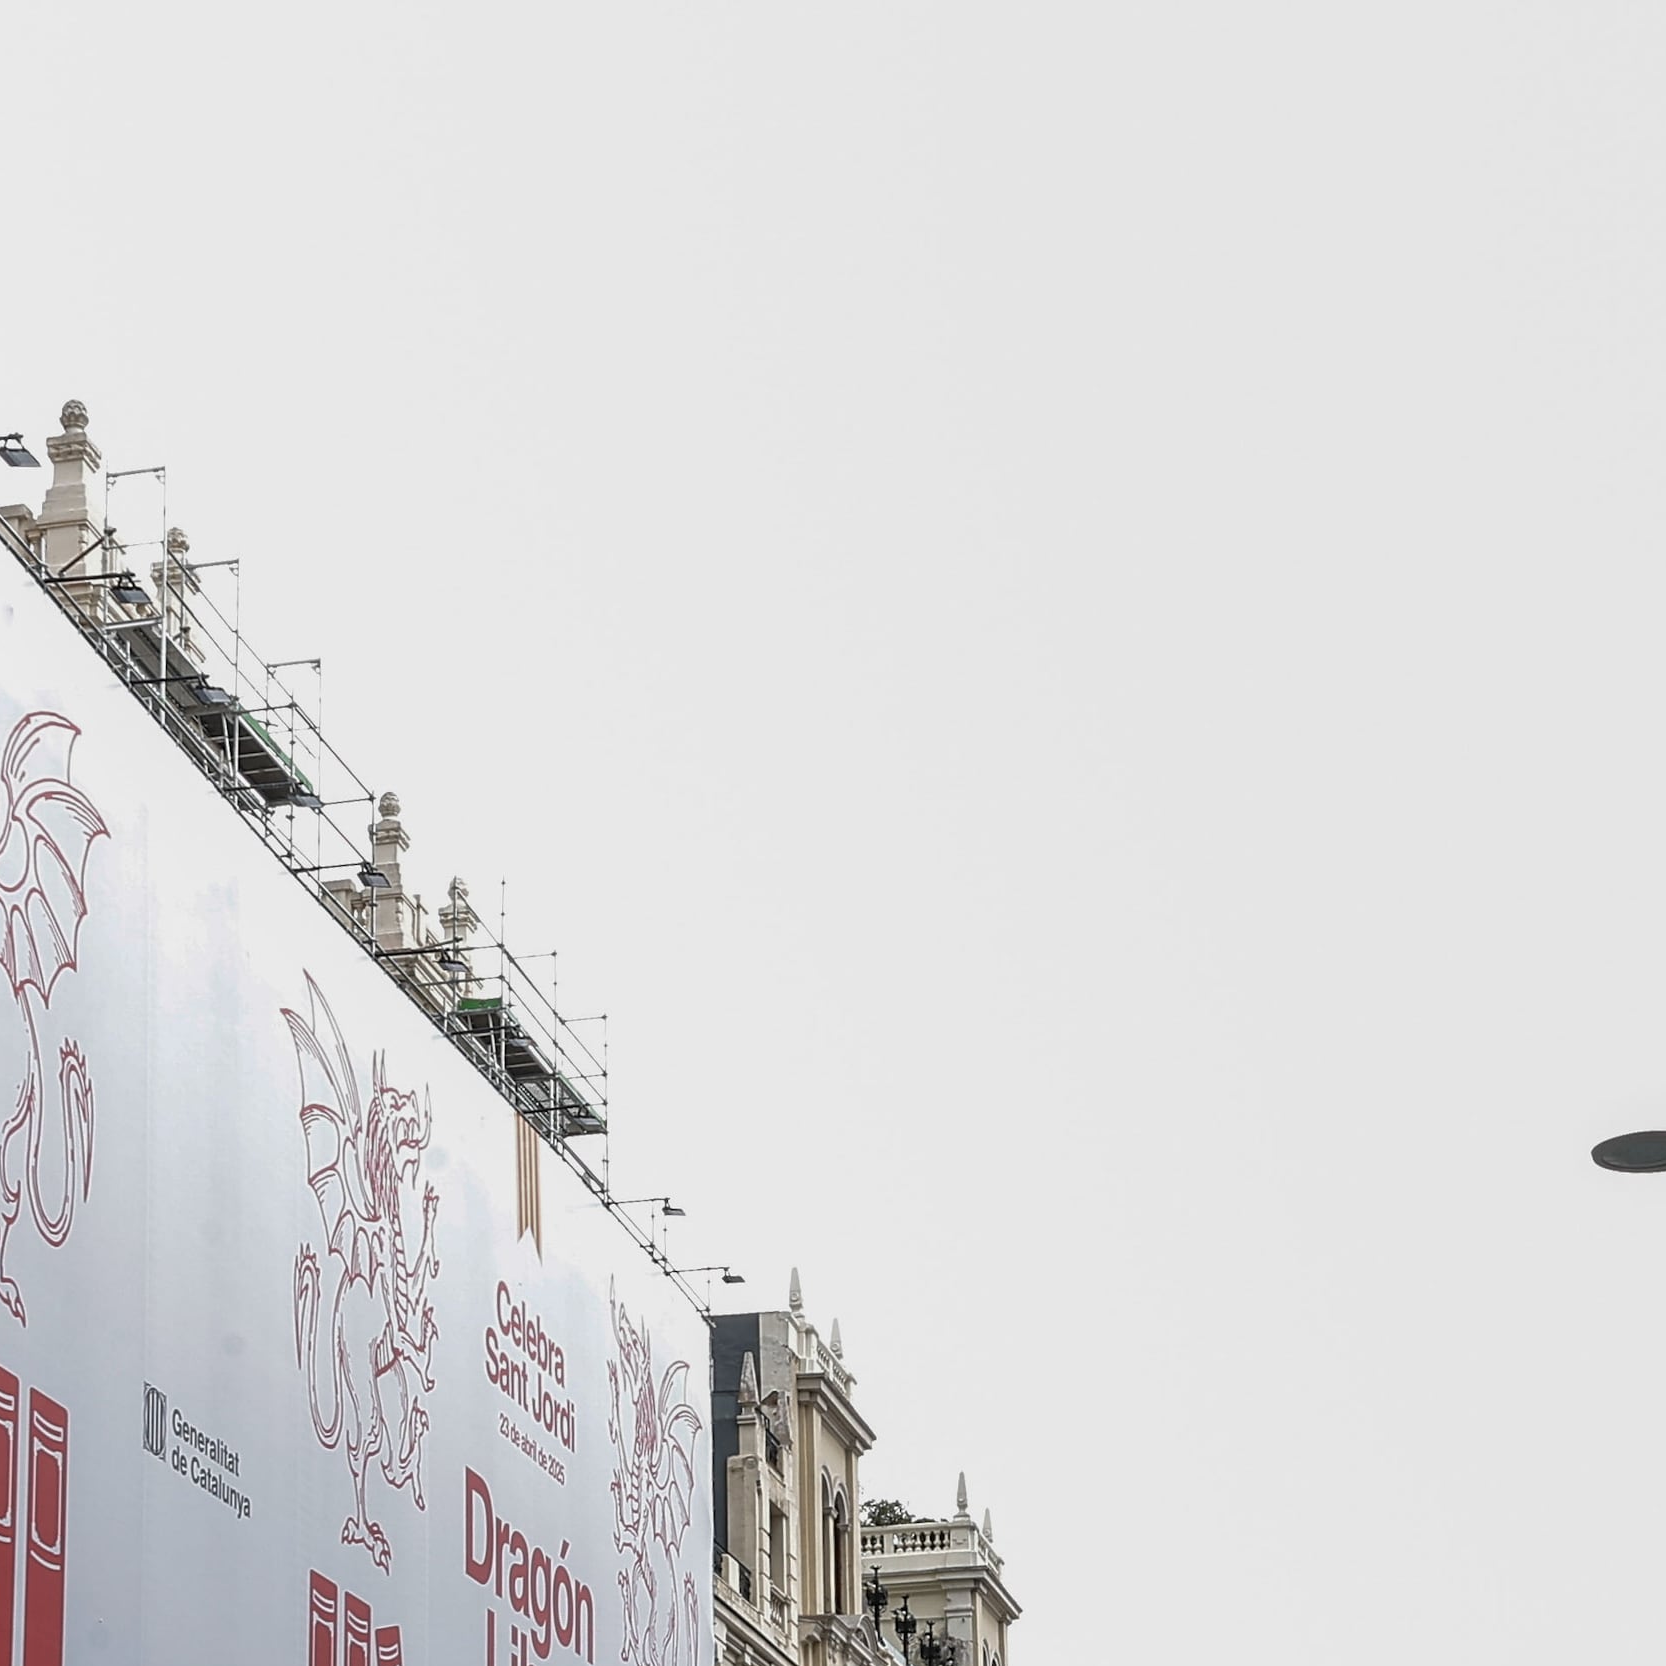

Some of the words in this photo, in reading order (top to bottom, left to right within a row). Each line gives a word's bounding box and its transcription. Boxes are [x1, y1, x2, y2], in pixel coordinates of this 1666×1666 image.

[496, 1281, 566, 1388] Celebra
[485, 1327, 529, 1413] Sant
[532, 1373, 575, 1453] Jordi
[171, 1445, 188, 1475] de
[190, 1456, 251, 1519] Catalunya
[172, 1408, 240, 1477] Generalitat
[499, 1412, 510, 1438] 23
[511, 1422, 521, 1447] de
[521, 1433, 537, 1462] abril
[538, 1447, 548, 1471] de
[548, 1454, 565, 1486] 2025
[465, 1466, 594, 1664] Dragón
